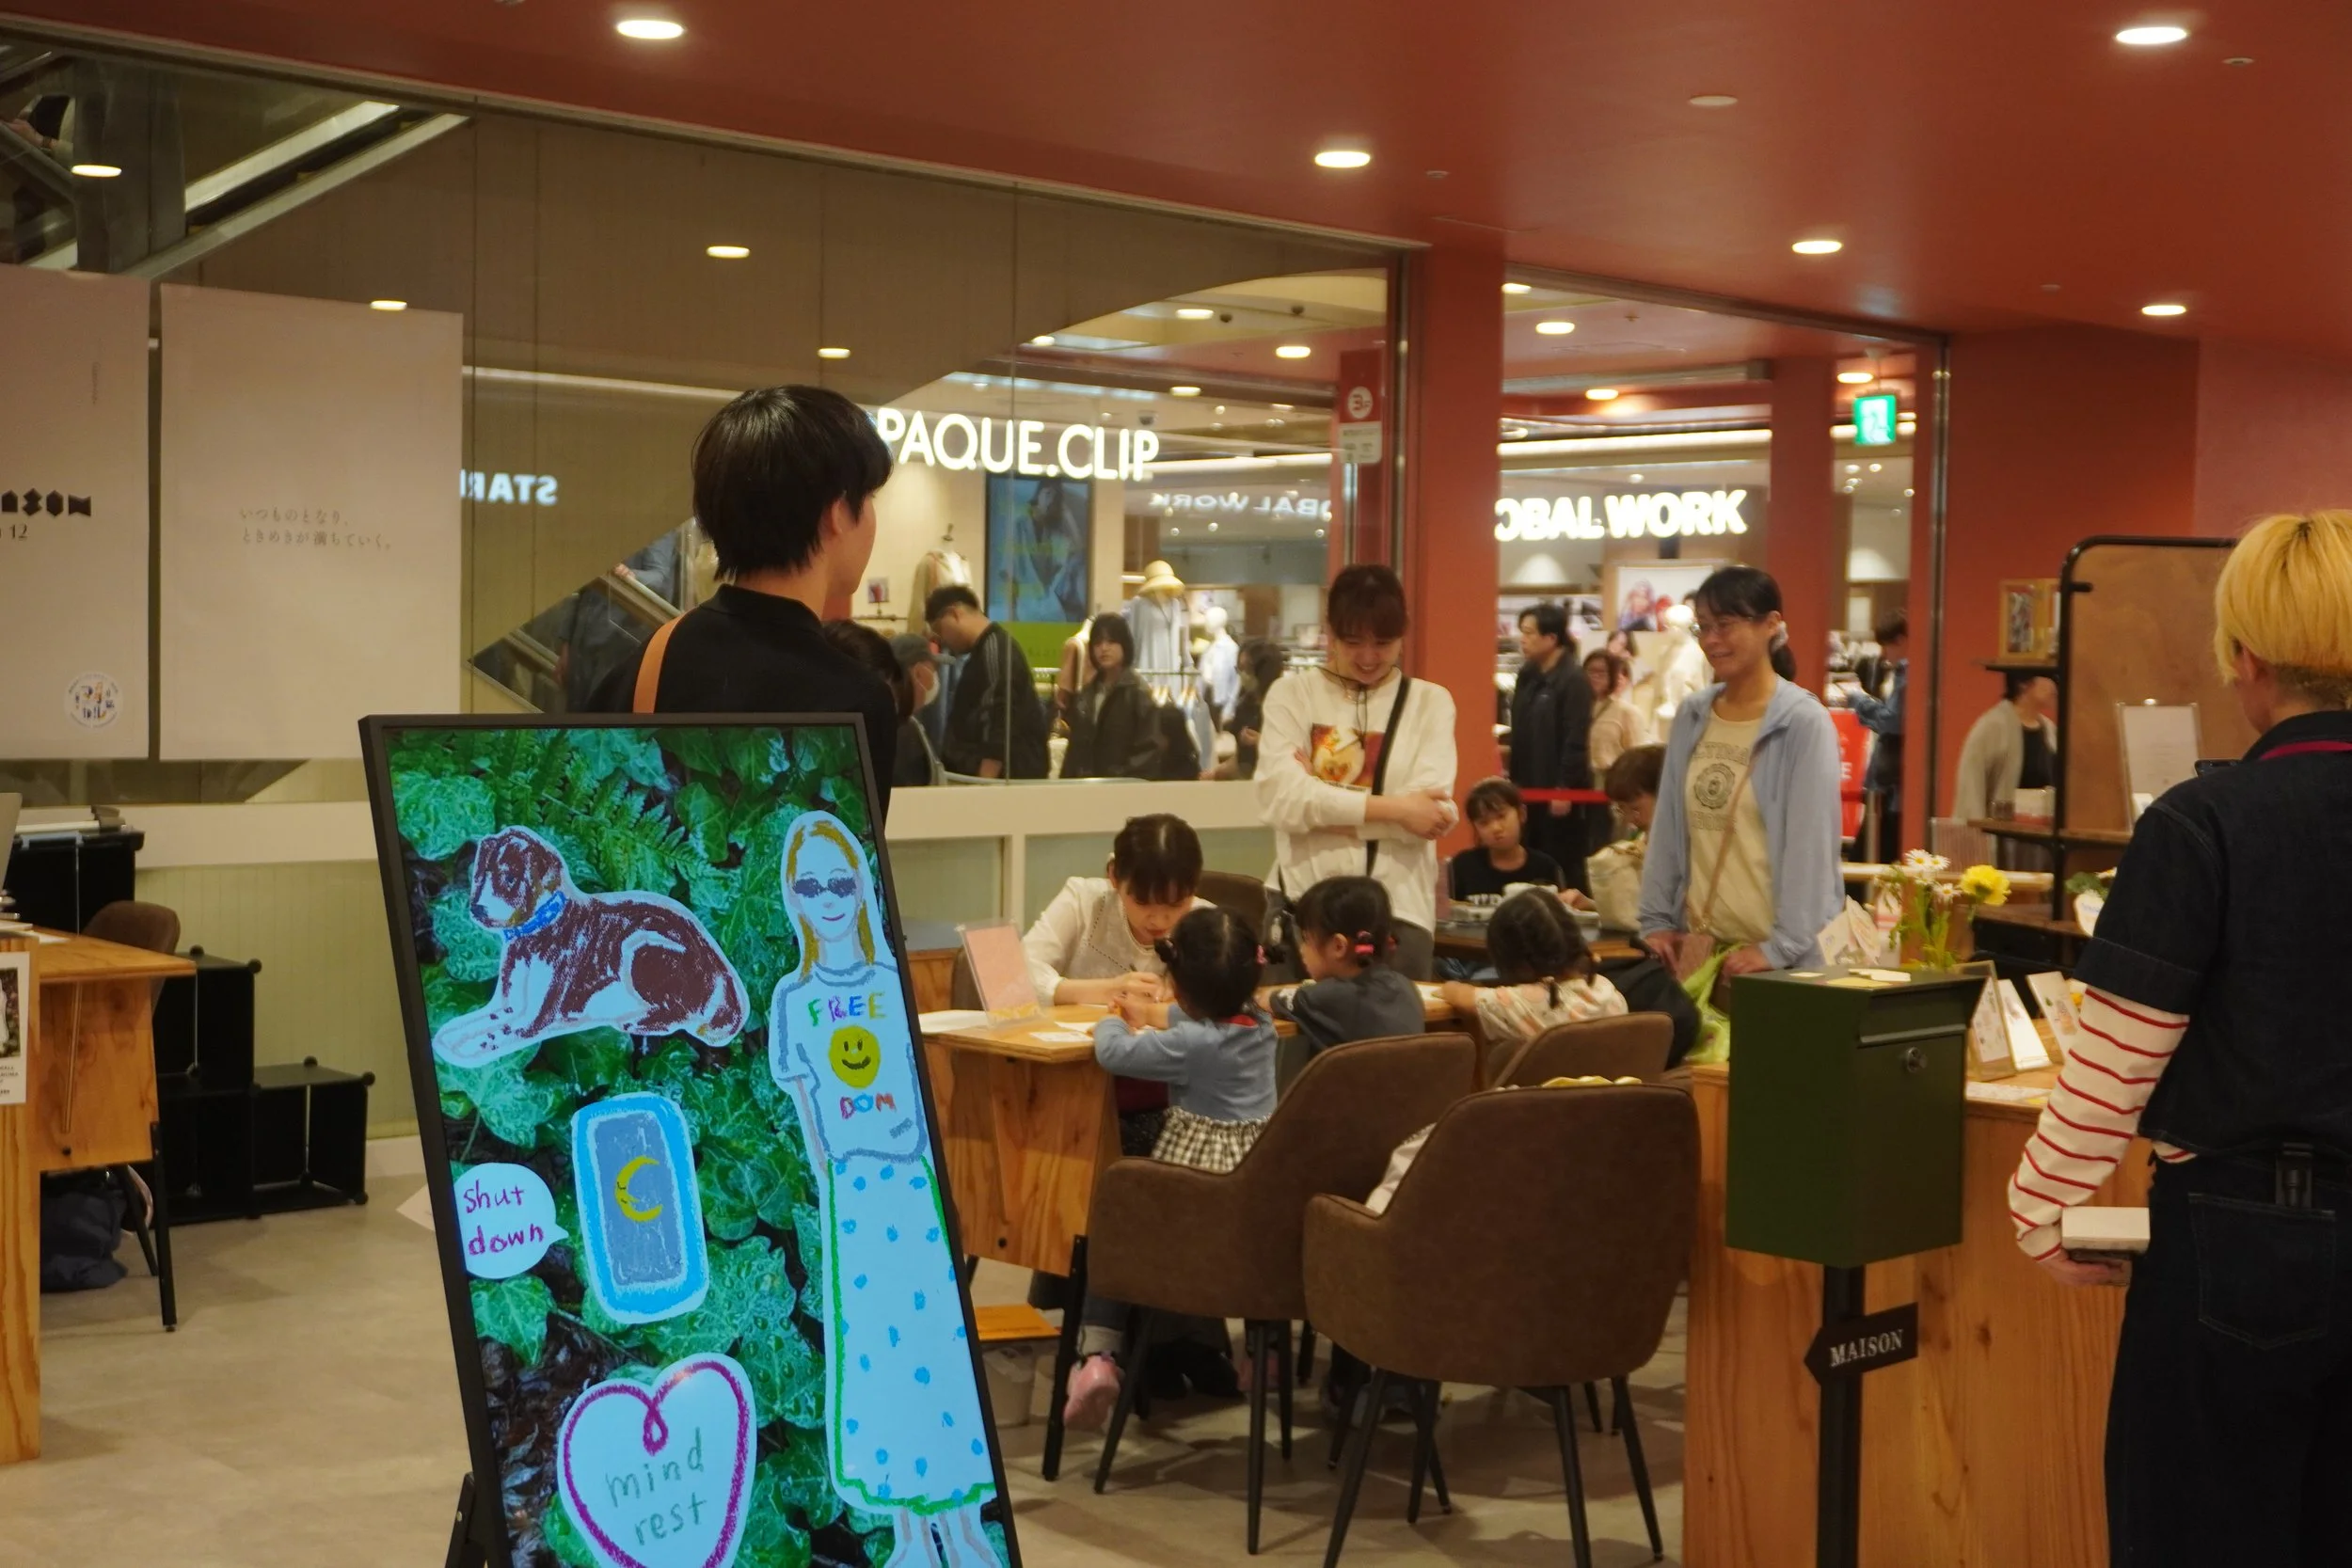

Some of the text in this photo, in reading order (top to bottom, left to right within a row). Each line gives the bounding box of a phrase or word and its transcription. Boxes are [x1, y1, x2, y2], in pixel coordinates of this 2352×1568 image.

[1604, 489, 1748, 538] WORK
[807, 991, 887, 1027] FREE
[839, 1092, 897, 1119] DOM
[469, 1223, 544, 1256] down
[1829, 1328, 1904, 1369] MAISON
[605, 1426, 705, 1509] mind
[635, 1492, 707, 1537] rest
